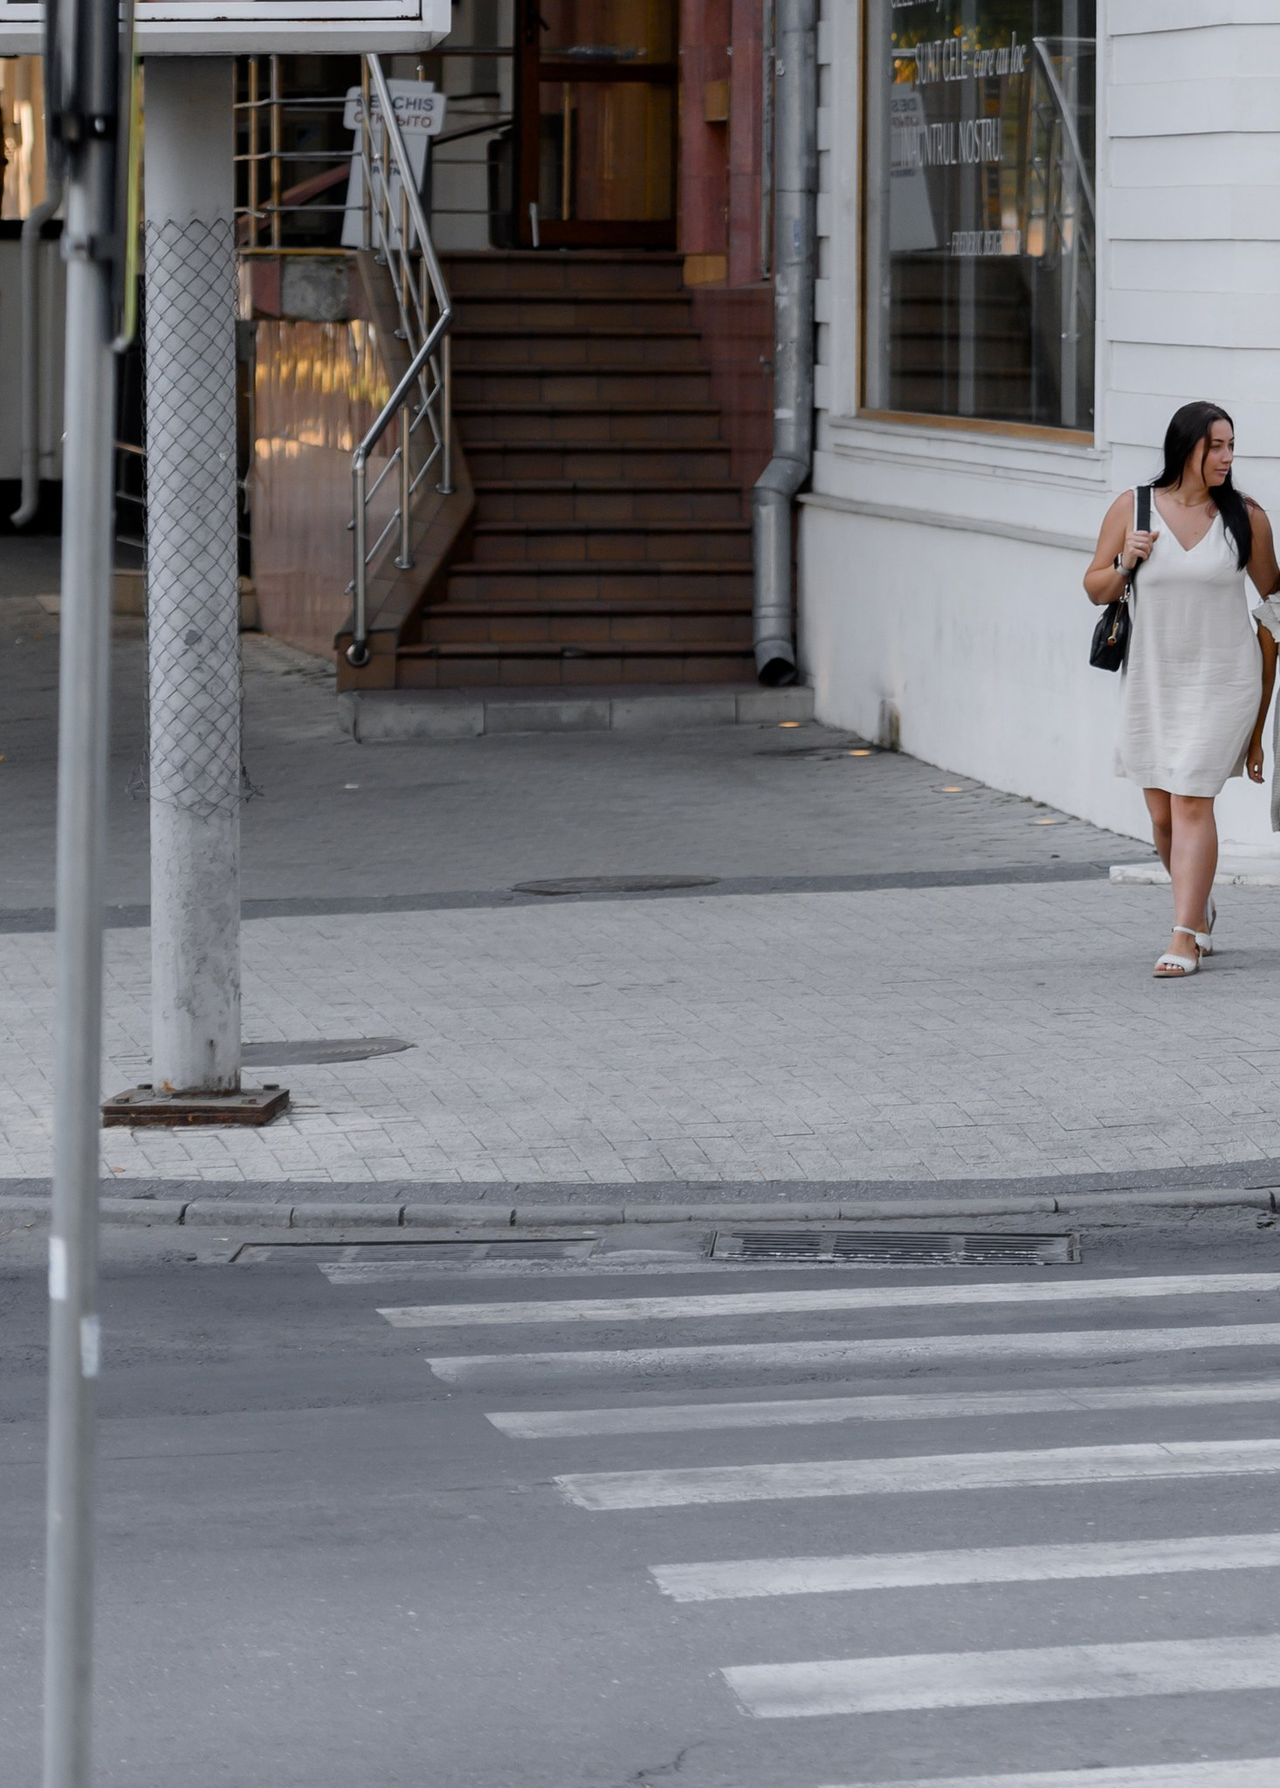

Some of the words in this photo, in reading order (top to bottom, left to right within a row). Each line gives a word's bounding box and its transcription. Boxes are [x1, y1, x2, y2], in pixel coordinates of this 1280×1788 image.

[915, 40, 942, 85] SUNT
[942, 36, 968, 81] CELE
[356, 94, 434, 112] ECHIS
[354, 111, 432, 129] ОТКЫТО
